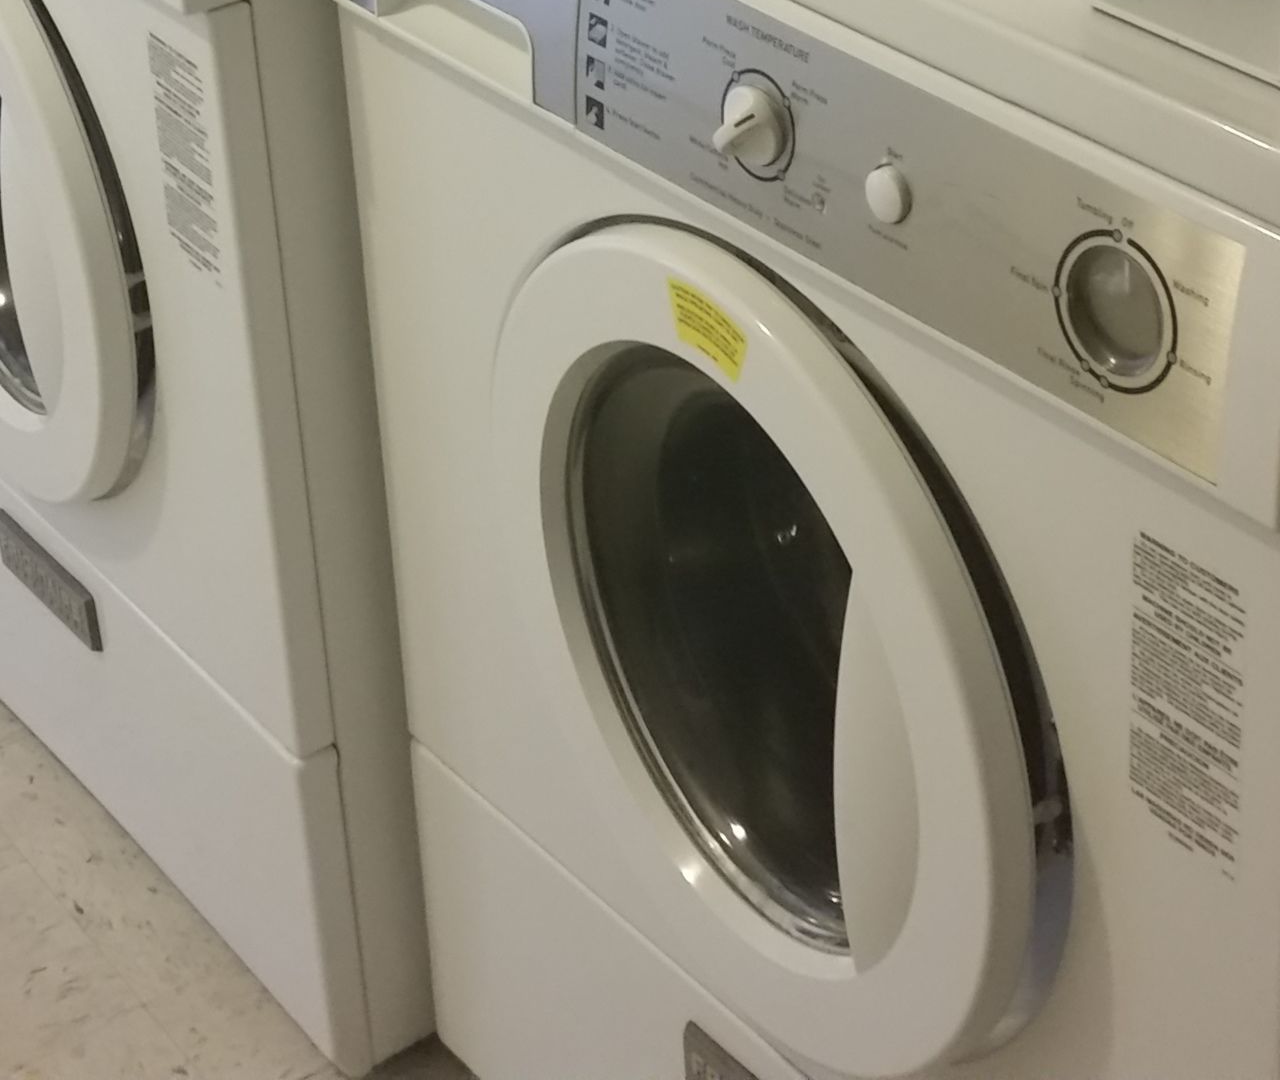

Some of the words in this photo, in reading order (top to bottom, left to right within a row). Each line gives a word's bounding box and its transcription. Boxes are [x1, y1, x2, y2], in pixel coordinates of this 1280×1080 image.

[725, 14, 750, 32] WASH
[751, 25, 810, 64] TEMPERATURE
[1173, 279, 1210, 307] Washing
